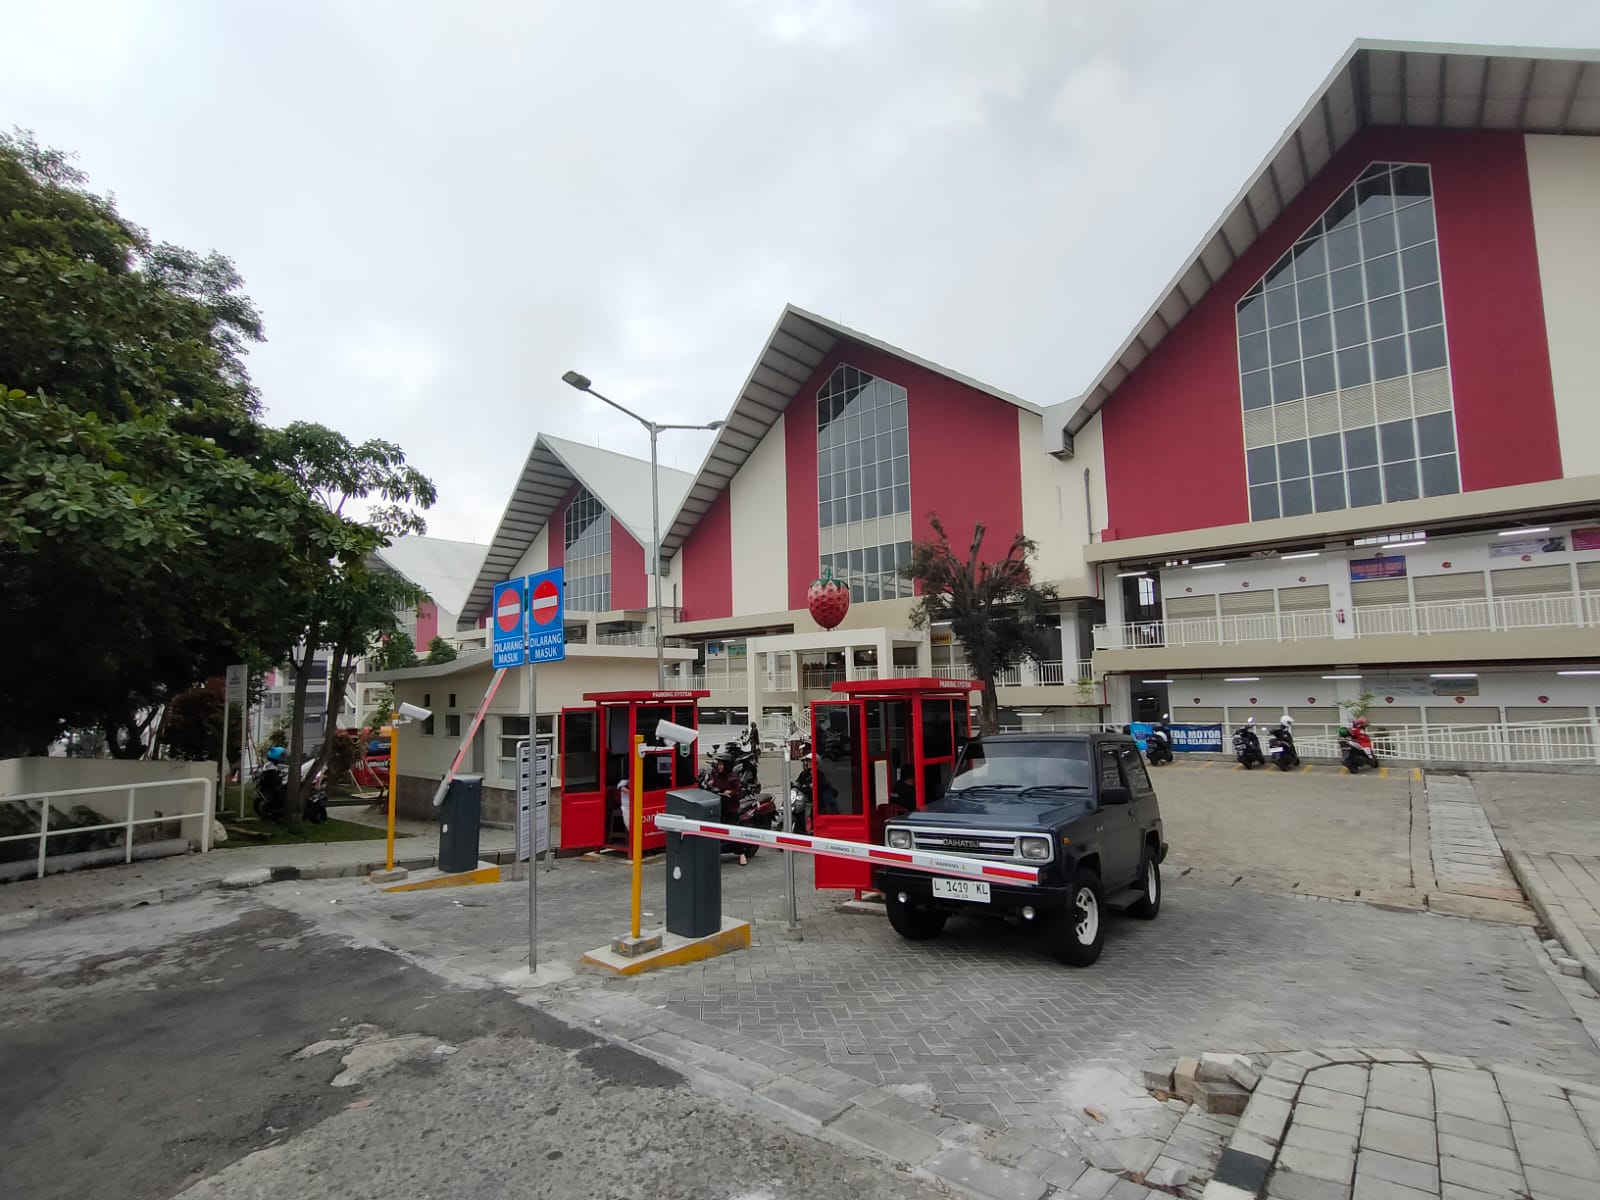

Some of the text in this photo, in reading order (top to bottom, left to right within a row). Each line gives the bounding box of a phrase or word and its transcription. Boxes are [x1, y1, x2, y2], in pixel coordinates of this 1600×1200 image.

[530, 633, 562, 647] DILARANG
[495, 640, 524, 653] DILARANG
[499, 653, 519, 664] MASUK
[535, 647, 558, 659] MASUK
[1188, 730, 1221, 738] MOTOR
[943, 838, 979, 848] DAIHATSU
[934, 880, 941, 891] L
[976, 883, 989, 895] KL
